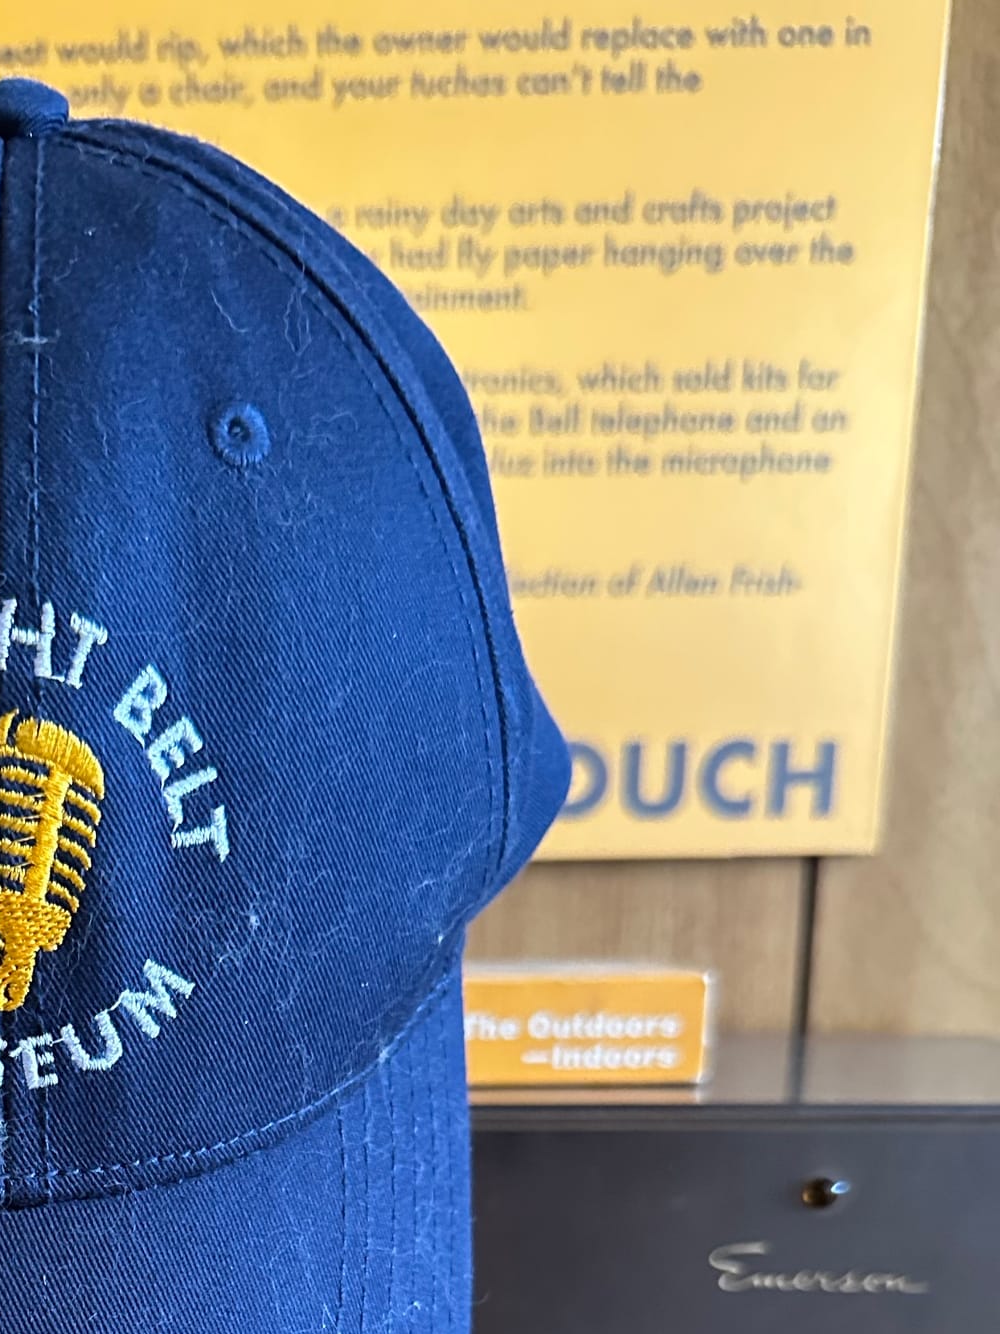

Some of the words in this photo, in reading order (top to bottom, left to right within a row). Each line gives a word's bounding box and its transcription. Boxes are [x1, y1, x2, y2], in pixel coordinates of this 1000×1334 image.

[55, 28, 149, 64] would
[218, 24, 307, 57] which
[316, 23, 362, 56] the
[373, 32, 467, 55] owner
[479, 18, 572, 52] would
[581, 16, 695, 60] replace
[706, 16, 768, 47] with
[778, 26, 834, 47] one
[845, 17, 871, 46] in
[264, 66, 323, 100] and
[333, 76, 400, 110] your
[517, 62, 592, 95] can't
[602, 60, 648, 94] tell
[656, 60, 702, 93] the
[355, 198, 430, 236] rainy
[440, 194, 497, 235] day
[508, 198, 563, 226] arts
[574, 191, 634, 225] and
[643, 188, 723, 225] crafts
[733, 193, 837, 232] project
[390, 237, 447, 271] had
[457, 235, 496, 278] fly
[505, 243, 593, 277] paper
[604, 235, 724, 276] hanging
[734, 243, 797, 266] over
[810, 232, 854, 265] the
[578, 360, 663, 393] which
[674, 361, 731, 393] sold
[742, 360, 788, 392] kits
[799, 358, 840, 391] for
[592, 402, 735, 440] telephone
[745, 400, 804, 433] and
[812, 410, 848, 433] an
[544, 446, 598, 476] into
[607, 444, 652, 476] the
[661, 442, 832, 482] microphone
[608, 562, 642, 597] of
[114, 664, 230, 863] BELT
[464, 1013, 520, 1041] The
[527, 1011, 681, 1039] Outdoors
[708, 1241, 930, 1292] Emerson
